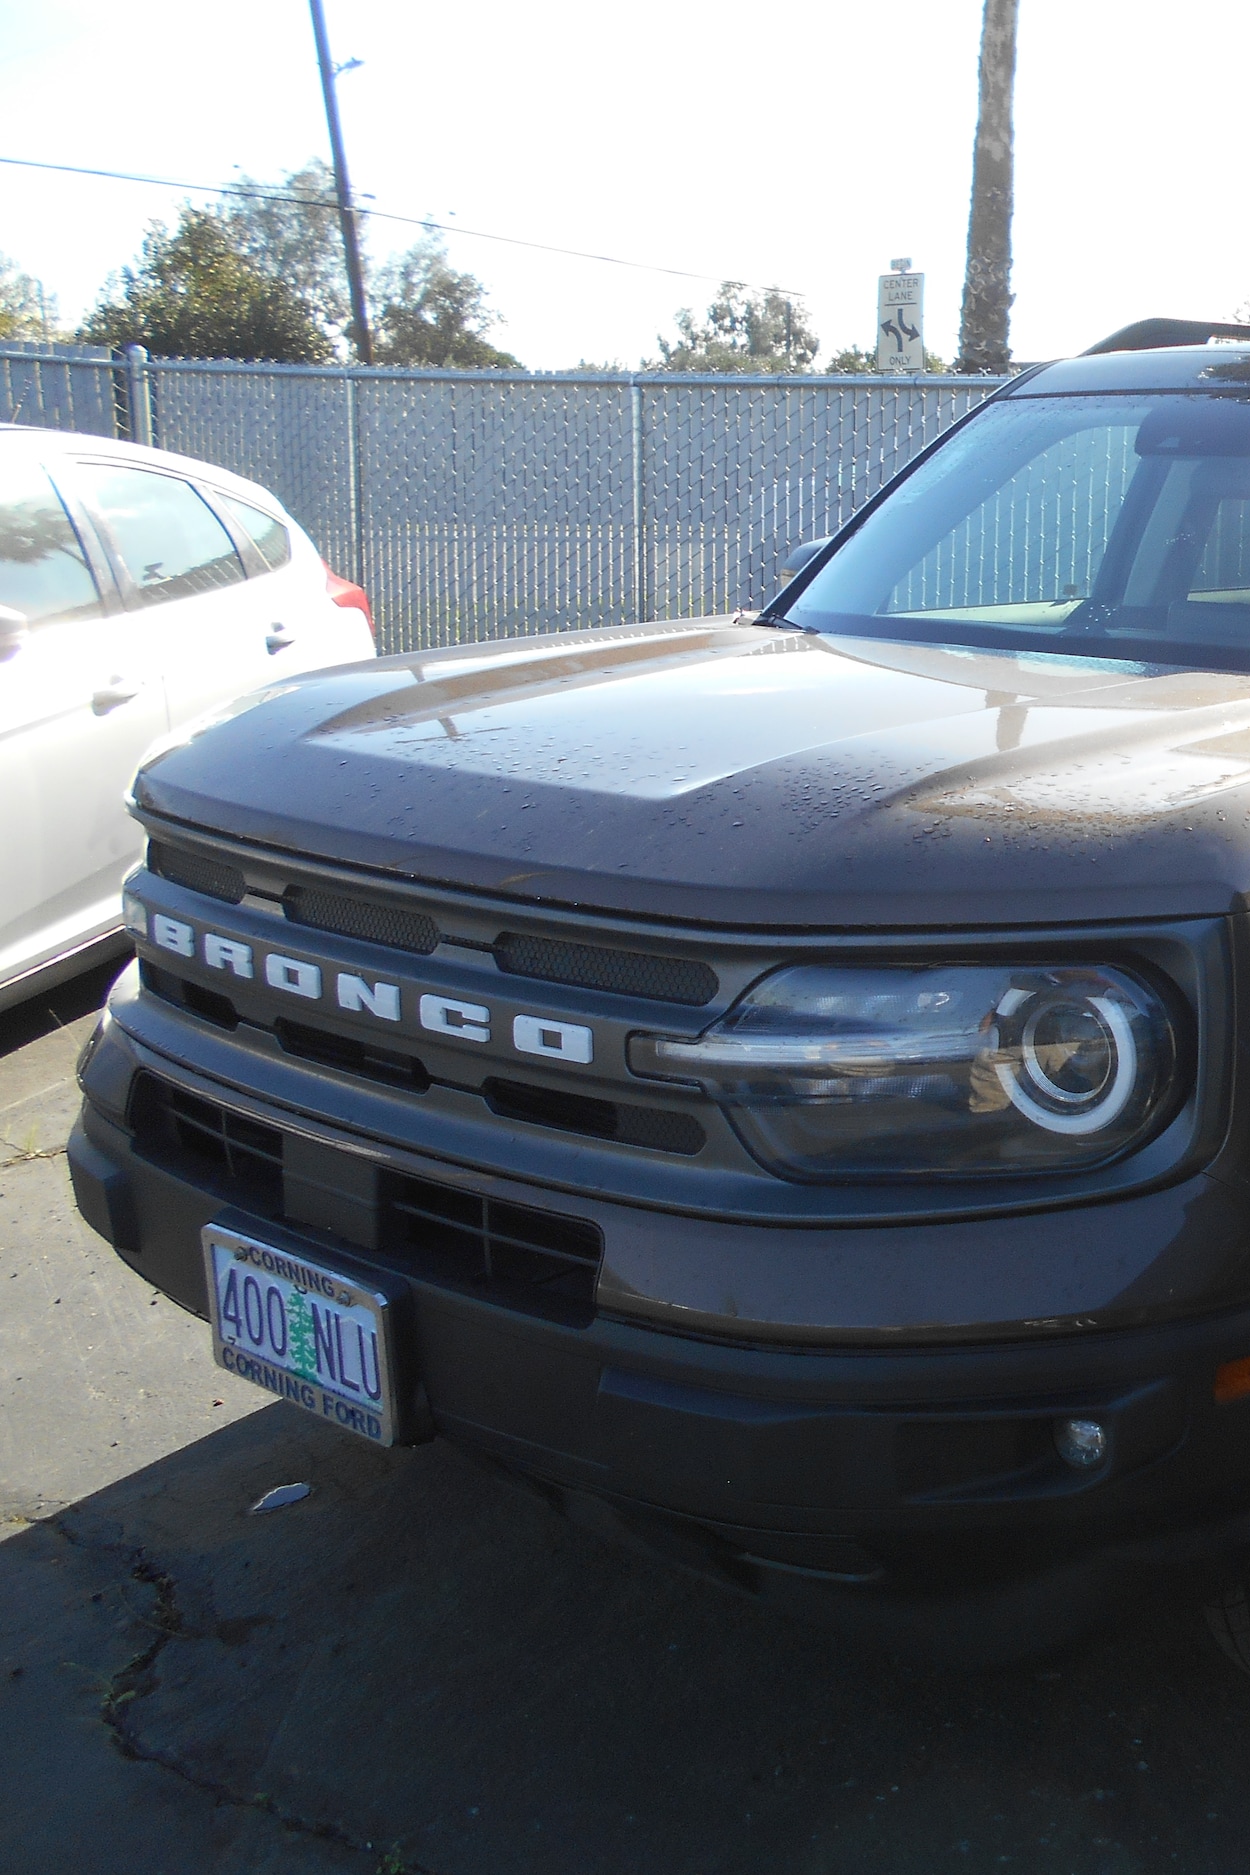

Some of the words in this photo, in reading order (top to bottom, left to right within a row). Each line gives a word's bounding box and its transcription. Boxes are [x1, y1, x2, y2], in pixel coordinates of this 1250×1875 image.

[883, 278, 919, 289] CENTER
[888, 291, 913, 301] LANE
[889, 356, 911, 366] ONLY
[154, 912, 594, 1064] BRONCO
[249, 1246, 336, 1297] CORNING
[223, 1268, 287, 1357] 400
[312, 1301, 382, 1401] NLU
[222, 1346, 316, 1409] CORNING
[323, 1394, 382, 1440] FORD
